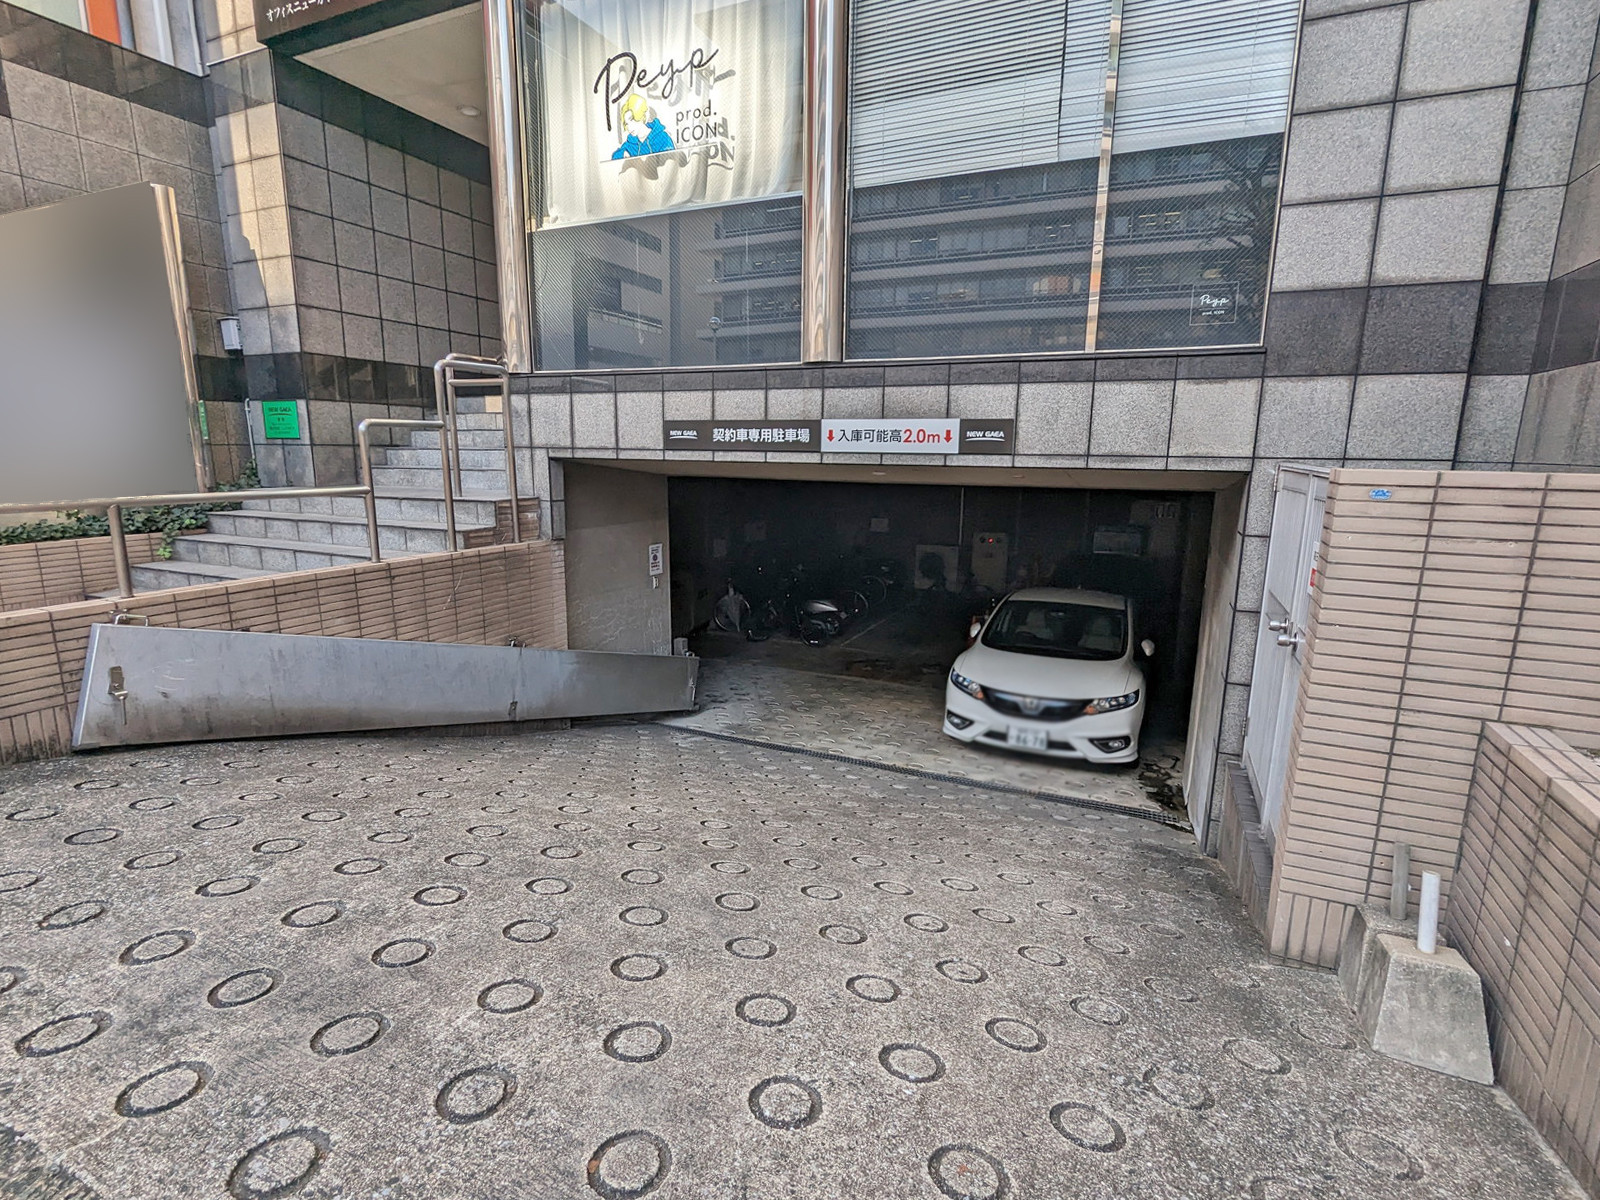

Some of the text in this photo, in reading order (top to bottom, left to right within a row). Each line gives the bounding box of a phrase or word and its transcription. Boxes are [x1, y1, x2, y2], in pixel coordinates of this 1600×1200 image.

[266, 0, 331, 21] オフィスニュー
[593, 48, 719, 132] Peyp
[676, 98, 717, 126] prod.
[676, 122, 717, 144] ICON
[712, 428, 810, 443] 契約車専用駐車場
[966, 430, 1005, 438] NEW GAEA
